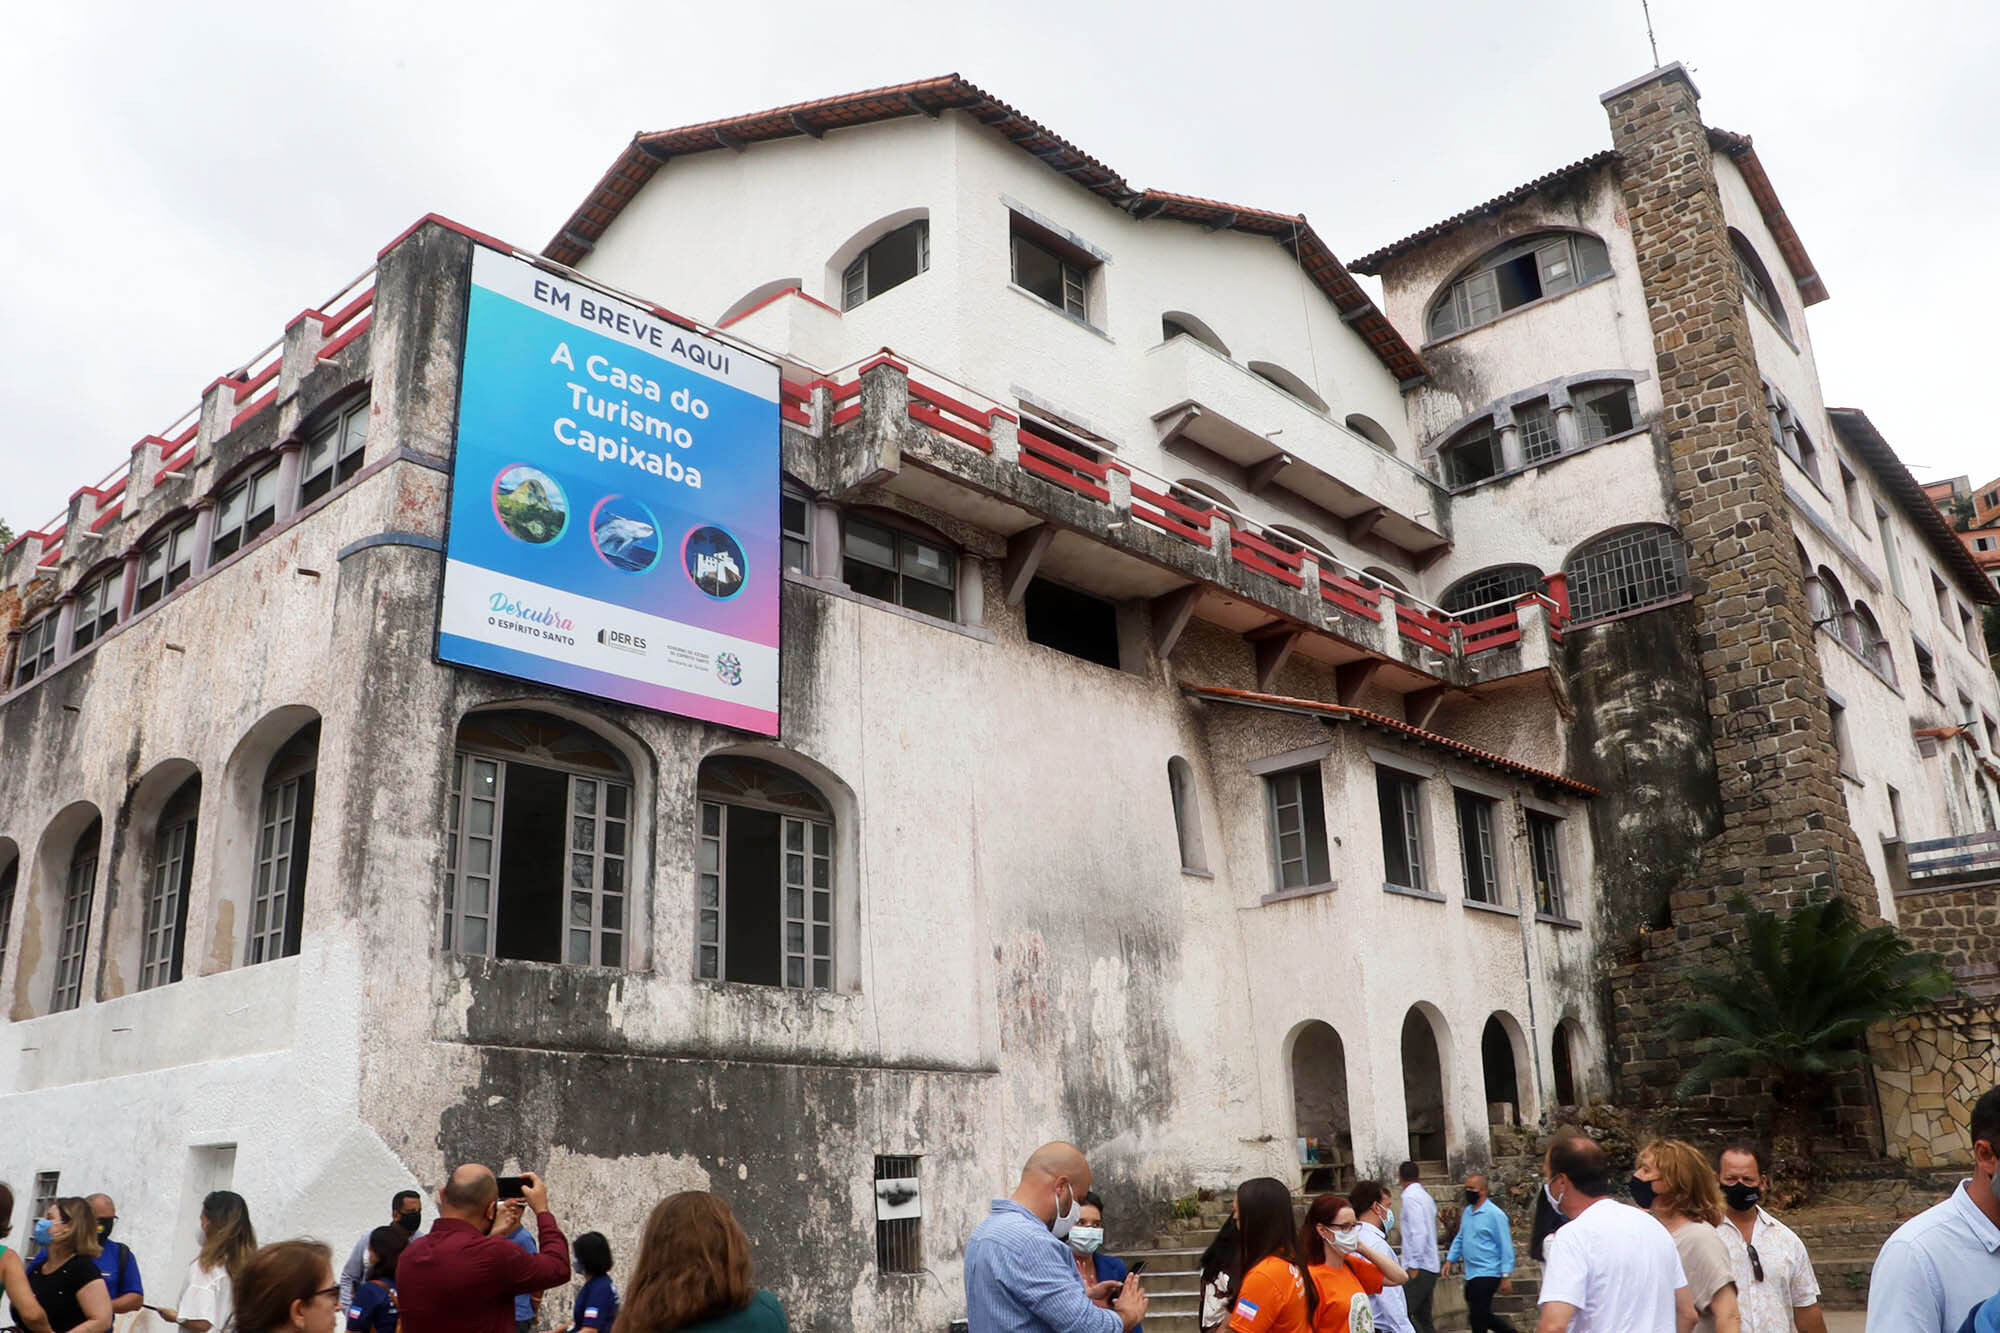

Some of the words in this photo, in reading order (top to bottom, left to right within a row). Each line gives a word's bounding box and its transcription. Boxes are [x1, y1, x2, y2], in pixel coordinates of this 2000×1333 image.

[533, 279, 571, 311] EM
[580, 299, 664, 348] BREVE
[670, 338, 730, 375] AQUI
[550, 342, 575, 371] A
[586, 355, 661, 402] Casa
[670, 388, 709, 420] do
[567, 382, 693, 449] Turismo
[554, 417, 702, 489] Capixaba
[488, 616, 496, 626] O
[498, 619, 540, 637] ESPÍRITO
[542, 631, 575, 646] SANTO
[489, 592, 575, 632] Descubra
